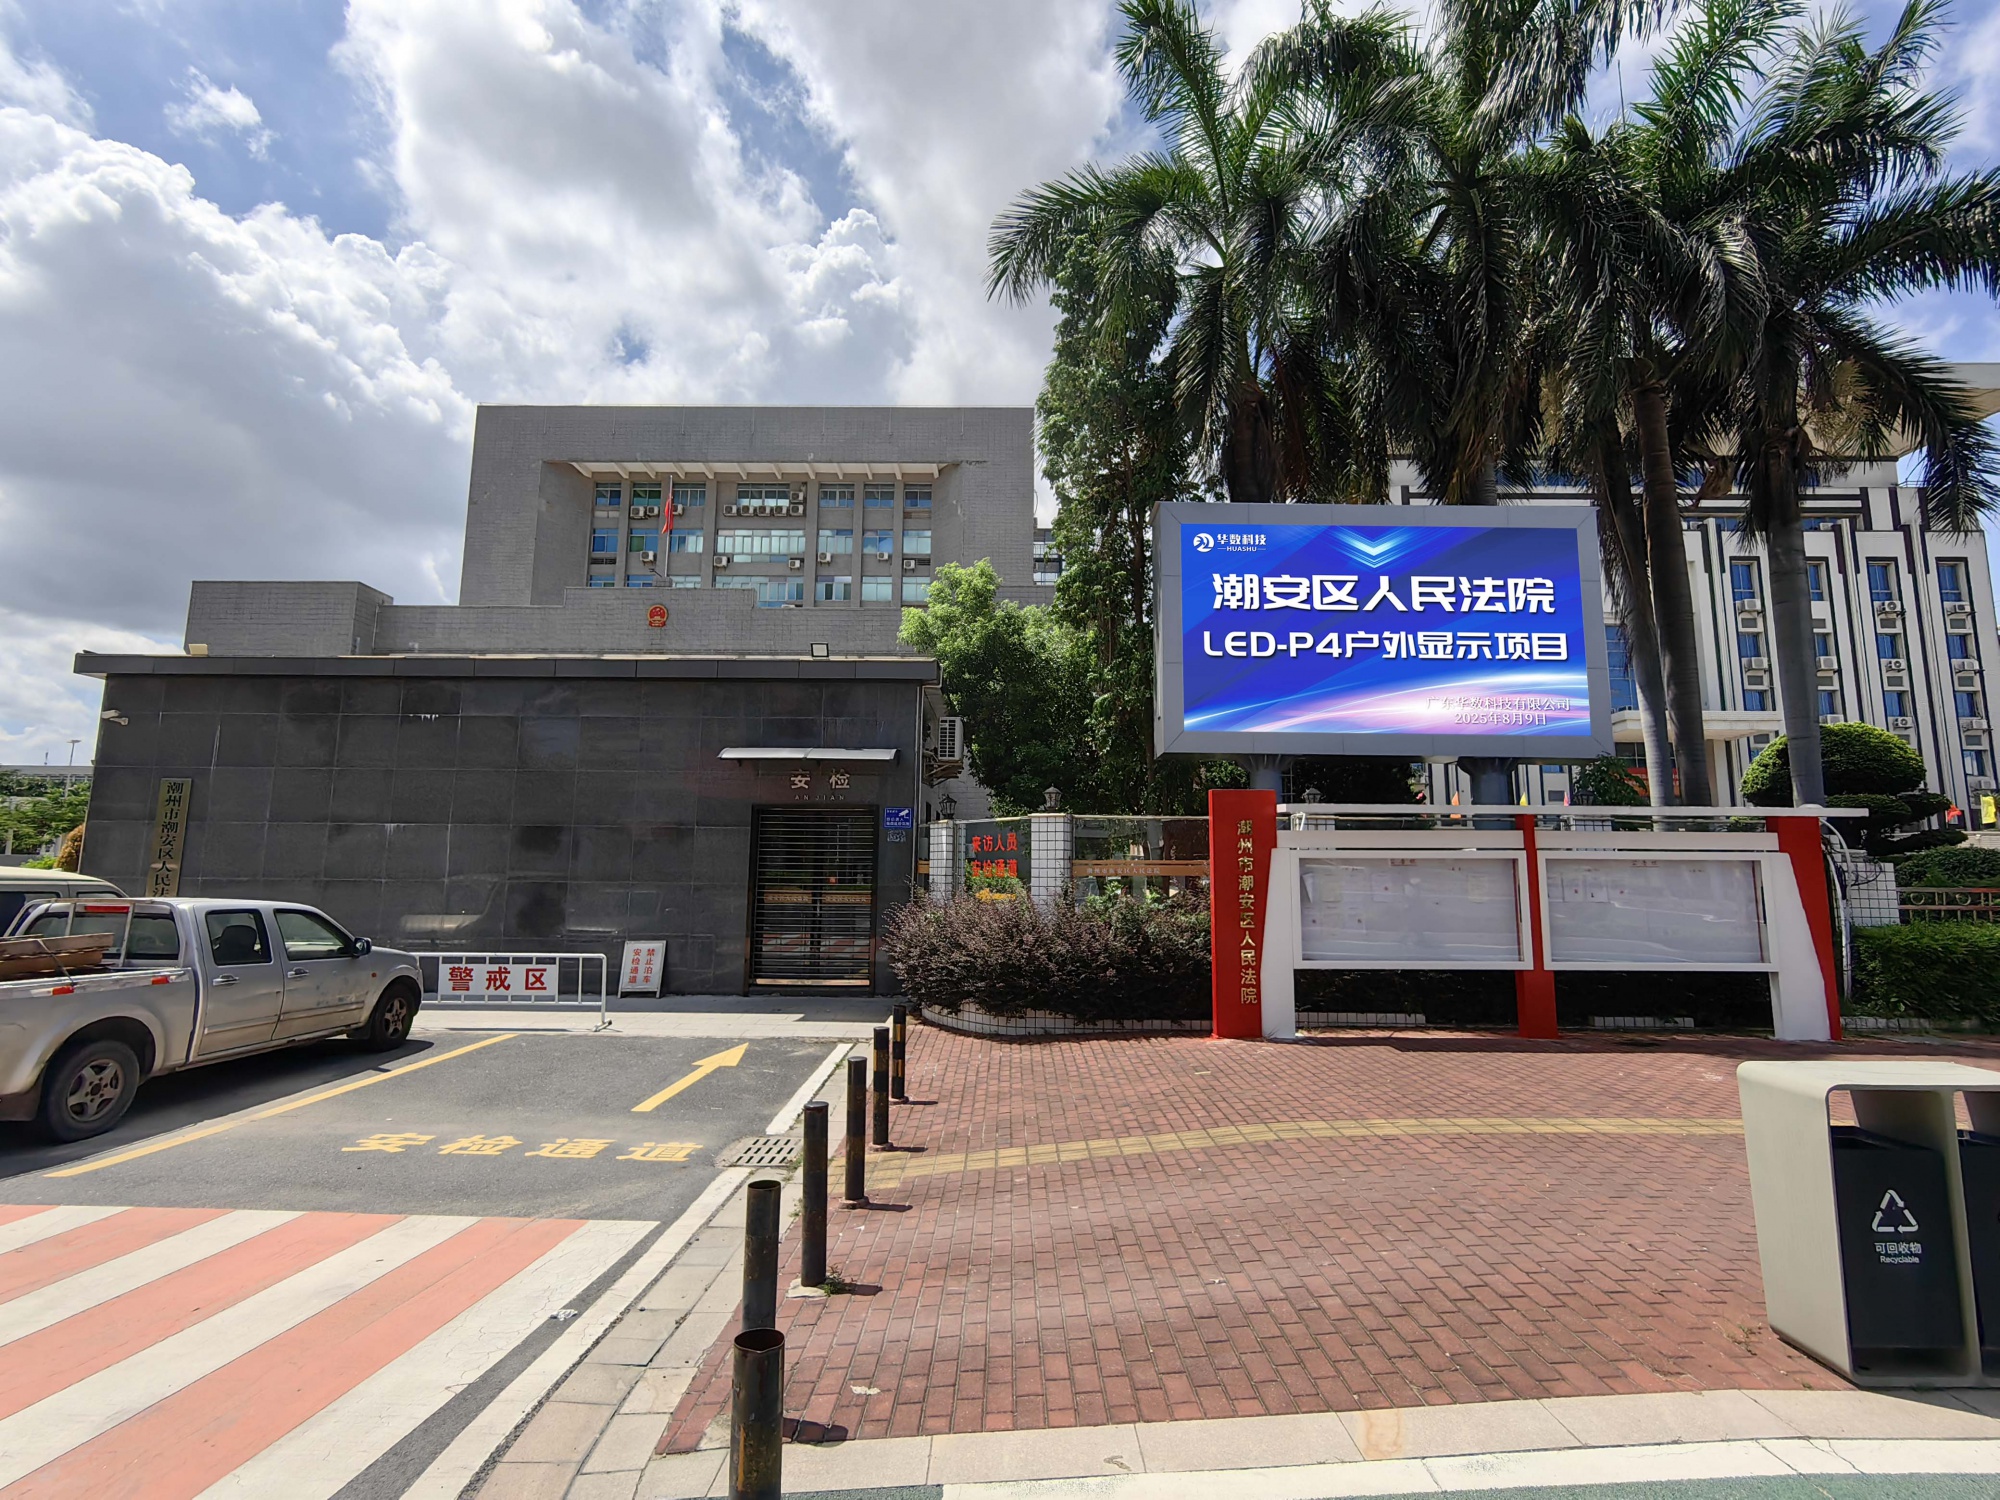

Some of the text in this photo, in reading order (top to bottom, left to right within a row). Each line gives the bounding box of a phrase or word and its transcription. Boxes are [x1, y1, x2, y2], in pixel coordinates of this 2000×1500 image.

[1217, 534, 1266, 545] 华数科技
[1212, 573, 1556, 613] 潮安区人民法院
[1203, 631, 1568, 661] LED-P4户外显示项目
[1426, 696, 1571, 711] 广东华数科技有限公司
[1454, 711, 1548, 726] 2025年8月9日
[790, 768, 850, 789] 安检
[971, 832, 1018, 852] 来访人员
[1237, 820, 1258, 1004] 潮州市潮安区人民法院
[643, 948, 656, 984] 禁止泊车
[448, 966, 548, 991] 警戒区
[341, 1132, 704, 1163] 安检通道
[1874, 1242, 1922, 1254] 可回收物
[1880, 1255, 1920, 1264] Recyclable
